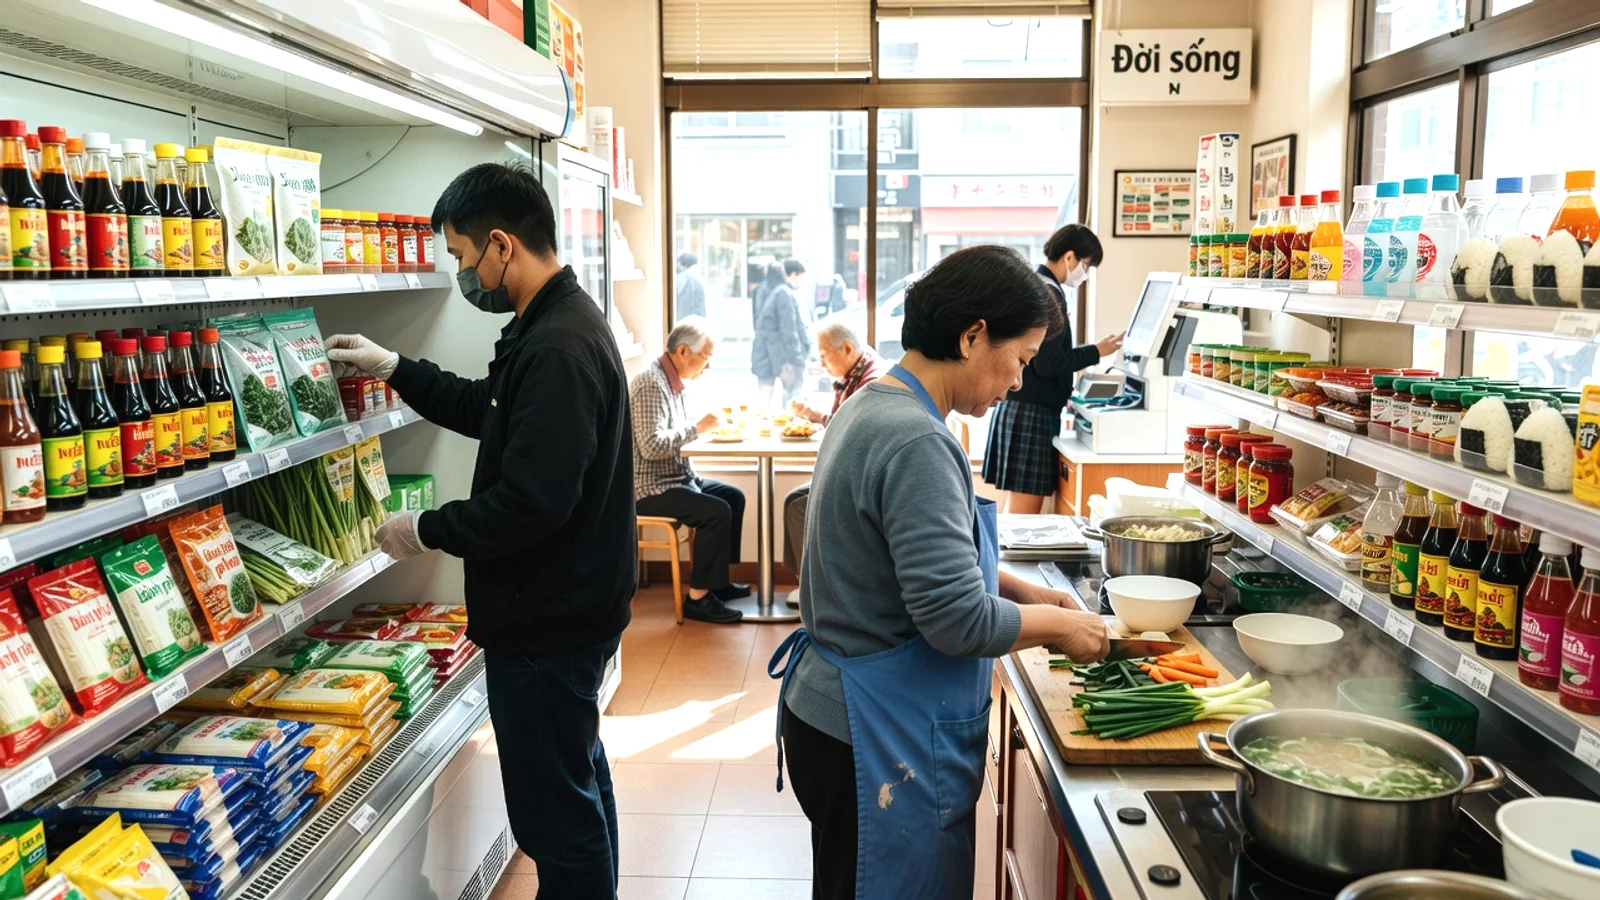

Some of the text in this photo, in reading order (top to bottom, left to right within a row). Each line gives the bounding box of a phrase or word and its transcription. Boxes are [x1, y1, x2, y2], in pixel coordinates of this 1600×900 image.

[1111, 37, 1241, 81] Đời sống
[1169, 82, 1181, 95] N
